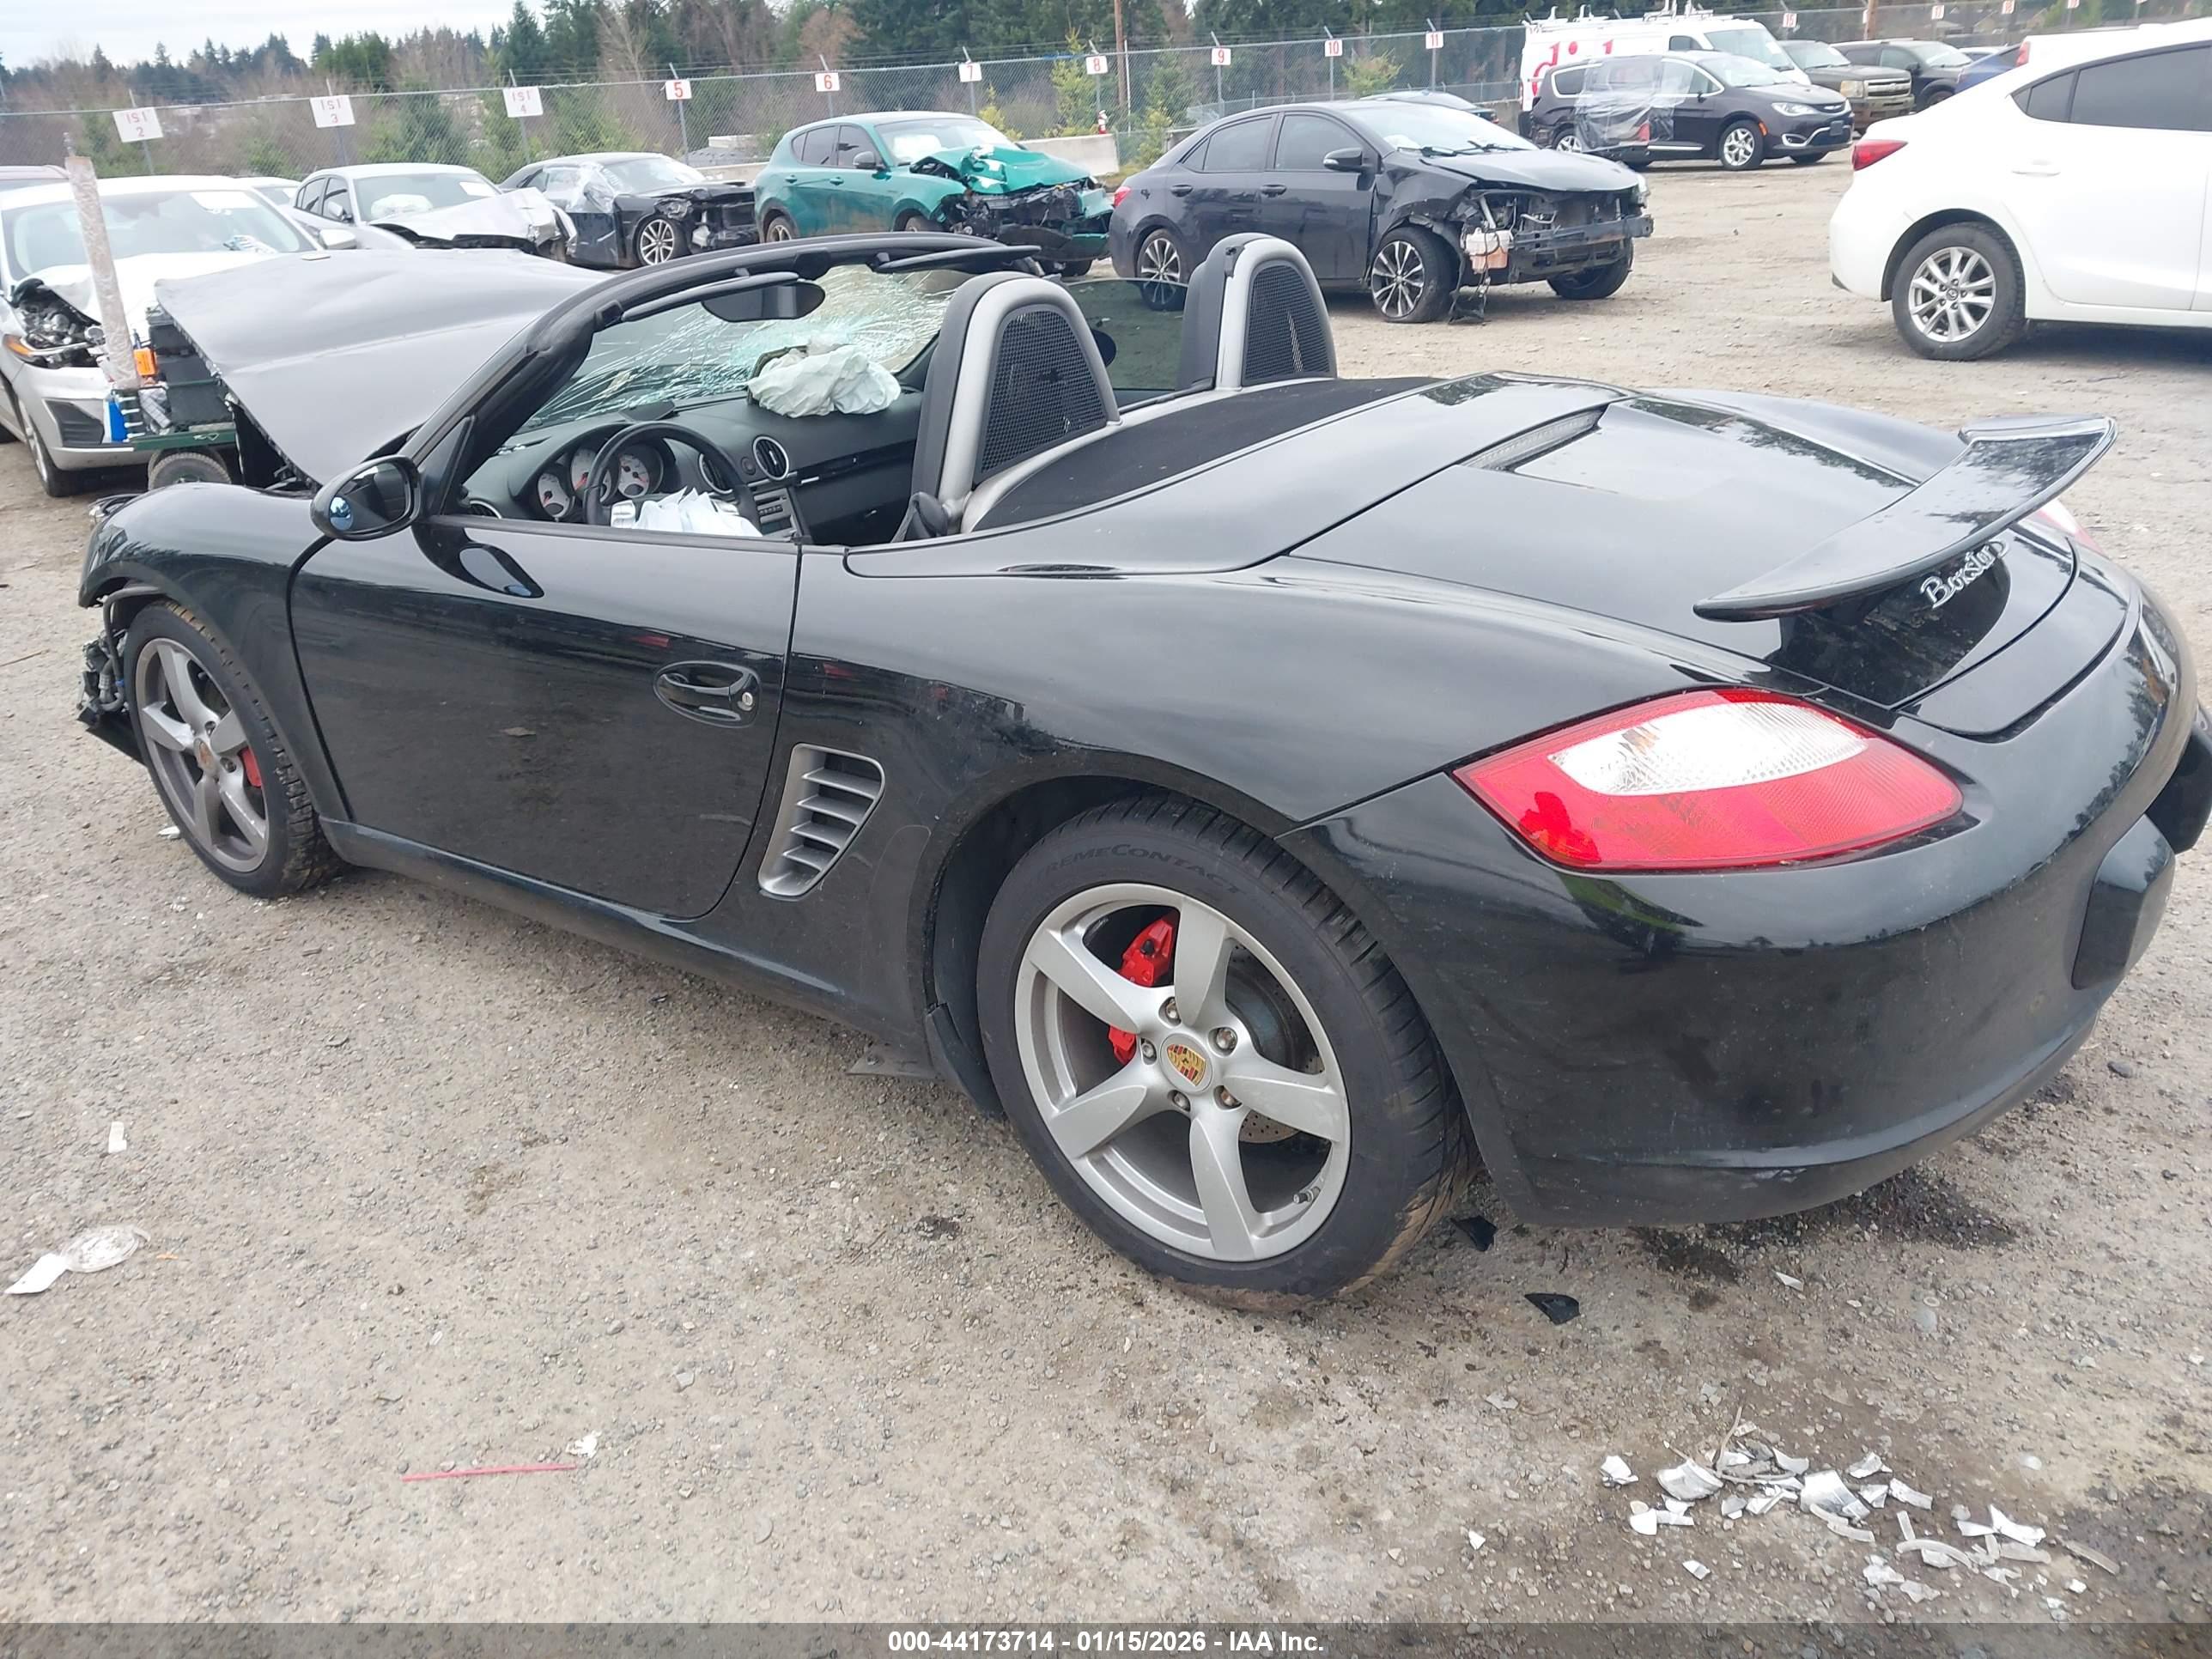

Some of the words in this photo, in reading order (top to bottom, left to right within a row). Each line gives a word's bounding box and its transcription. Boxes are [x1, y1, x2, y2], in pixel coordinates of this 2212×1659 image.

[1431, 33, 1438, 46] 11
[1328, 40, 1340, 55] 10
[1218, 49, 1224, 64] 9
[1093, 58, 1101, 72] 8
[823, 74, 833, 90] 6
[673, 82, 684, 98] 5
[520, 104, 527, 114] 4
[330, 113, 338, 124] 3
[136, 126, 145, 137] 2
[1920, 543, 1999, 609] Boxster
